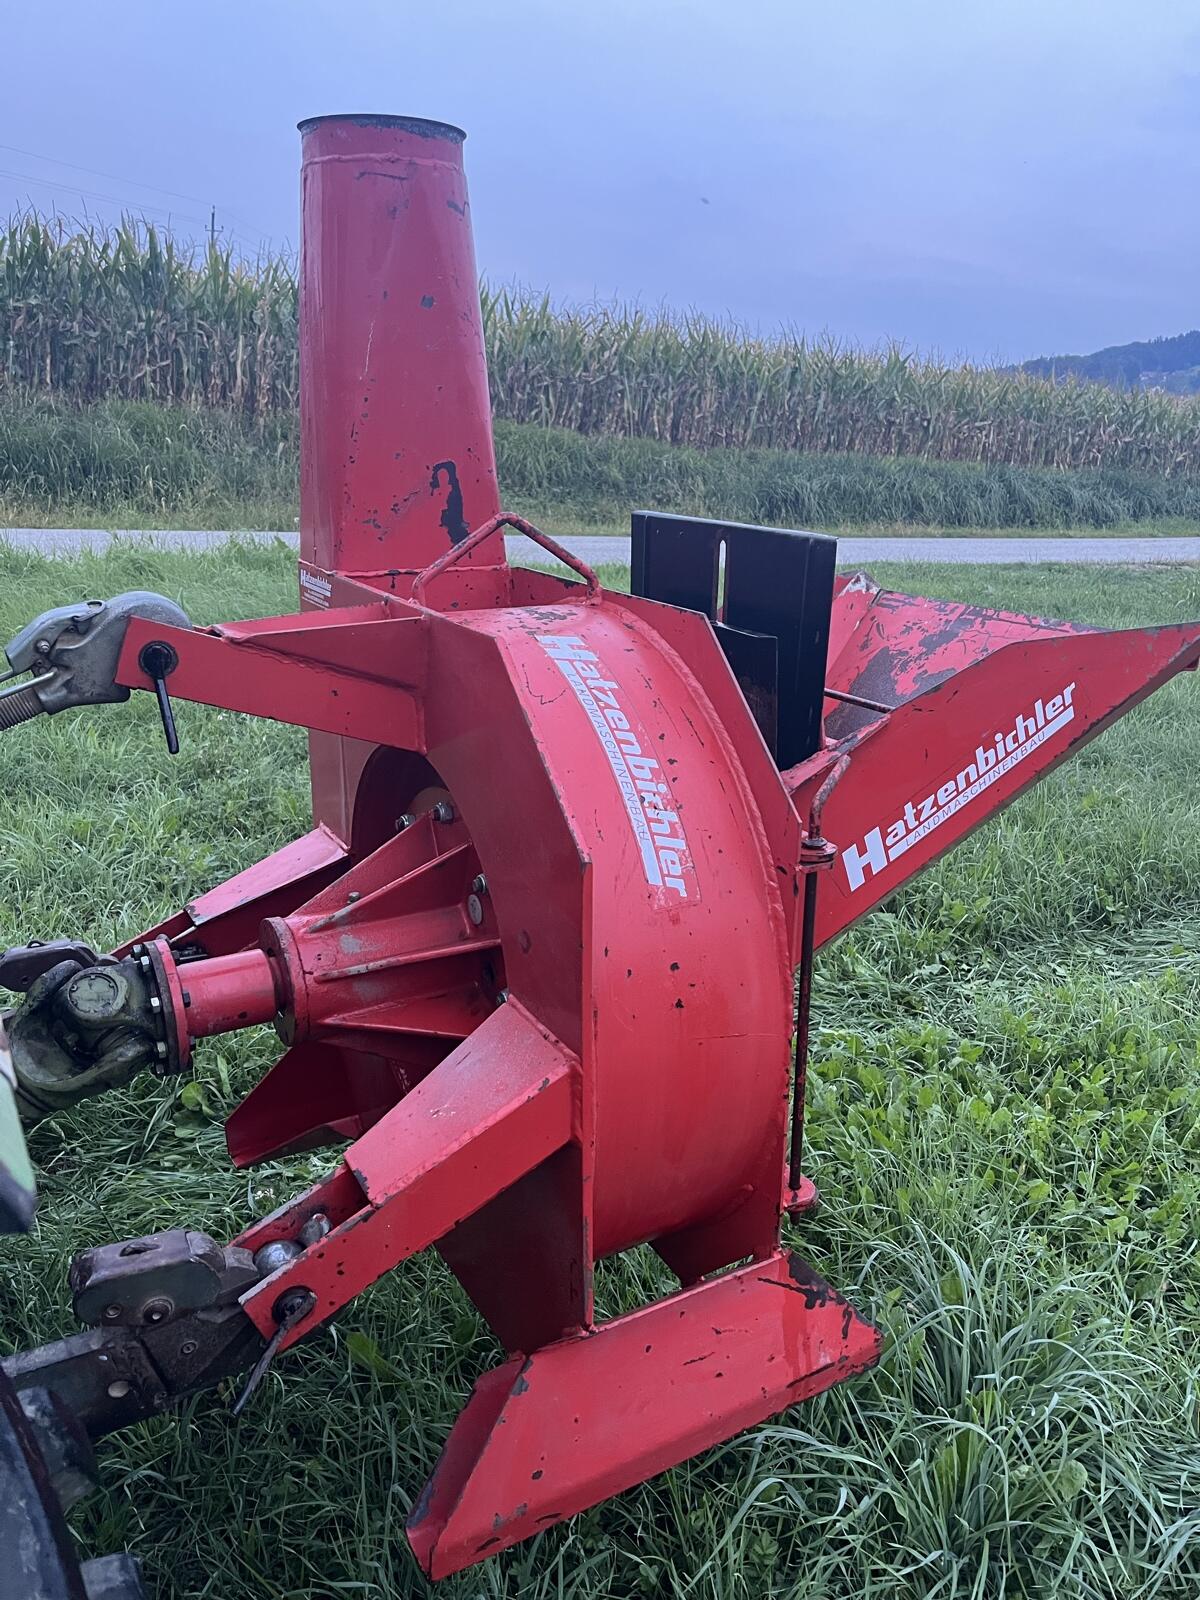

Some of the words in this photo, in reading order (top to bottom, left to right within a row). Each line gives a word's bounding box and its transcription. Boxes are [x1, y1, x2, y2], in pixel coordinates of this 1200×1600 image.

[535, 634, 687, 898] Hatzenbichler
[569, 672, 651, 841] LANDMASCHINENBAU
[842, 682, 1076, 892] Hatzenbichler
[905, 732, 1046, 847] LANDMASCHINENBAU
